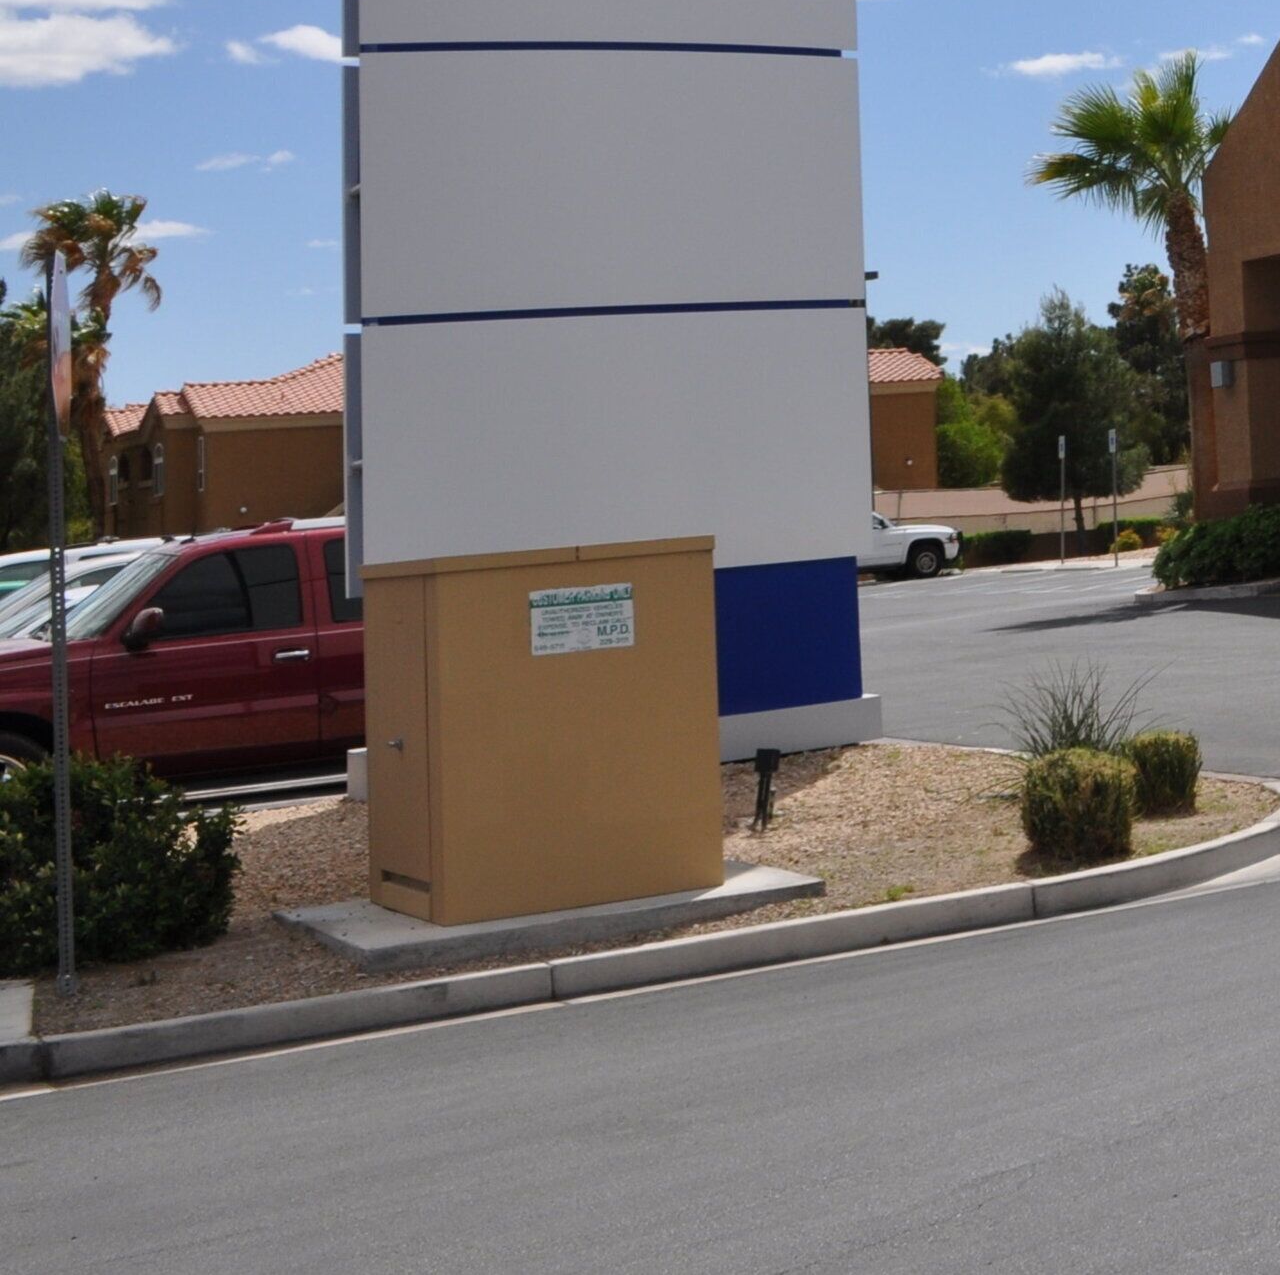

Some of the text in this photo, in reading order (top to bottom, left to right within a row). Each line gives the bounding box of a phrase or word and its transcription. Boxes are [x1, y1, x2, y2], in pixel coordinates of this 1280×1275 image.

[596, 623, 630, 636] M.P.D.
[105, 694, 193, 709] ESCALADE EXT
